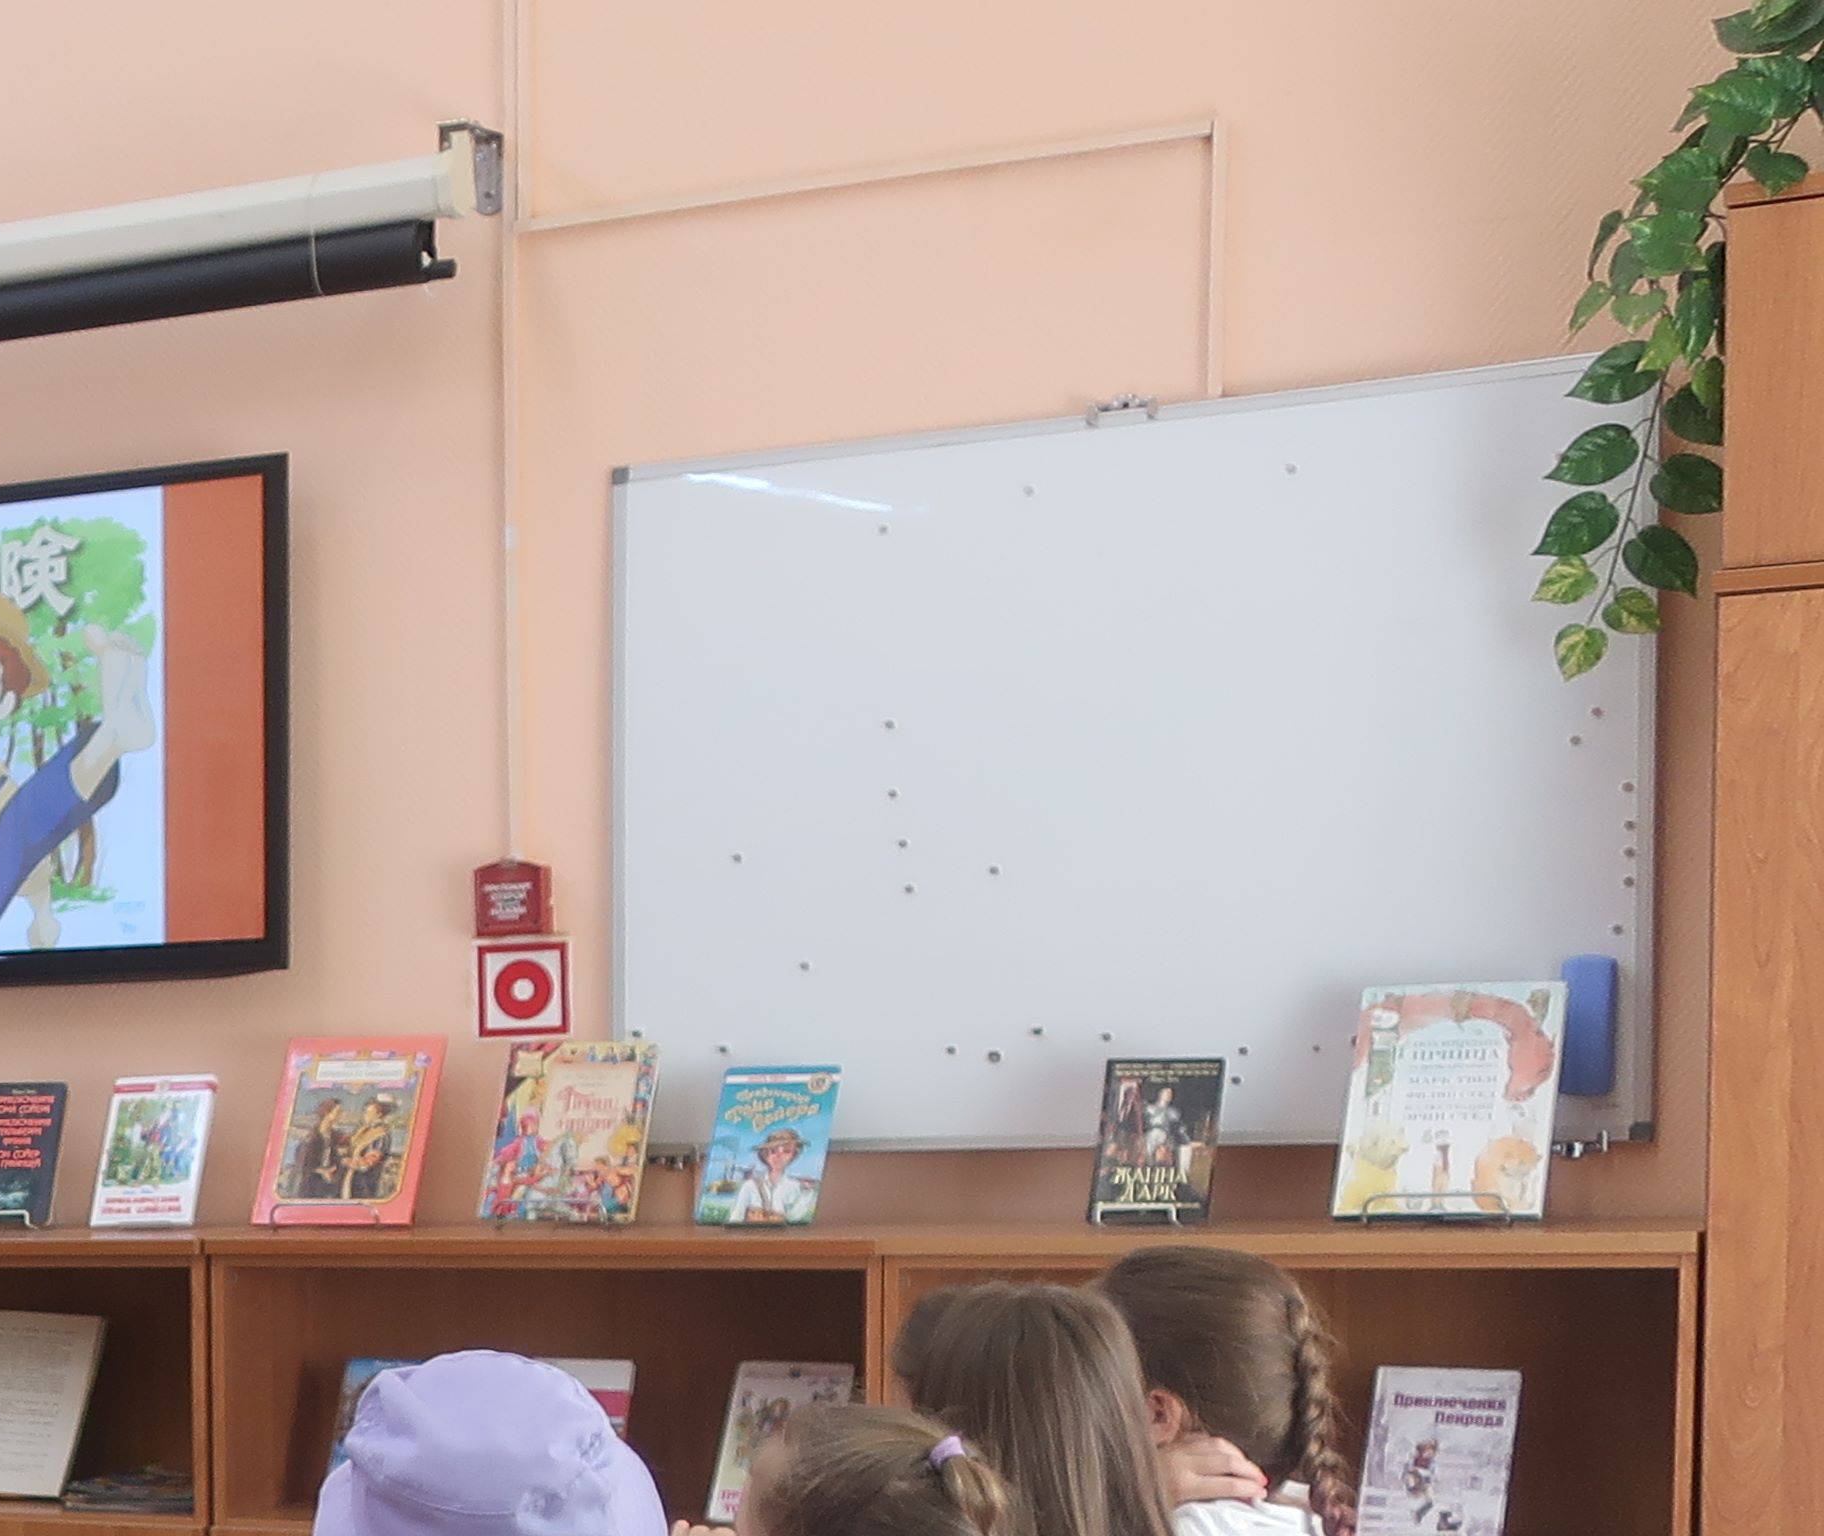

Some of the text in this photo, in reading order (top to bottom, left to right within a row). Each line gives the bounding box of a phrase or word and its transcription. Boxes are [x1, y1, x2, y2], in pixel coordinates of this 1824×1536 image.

[1114, 1166, 1188, 1184] ЖАННА
[1394, 1391, 1507, 1413] Приключения
[1434, 1411, 1505, 1428] Пенрода
